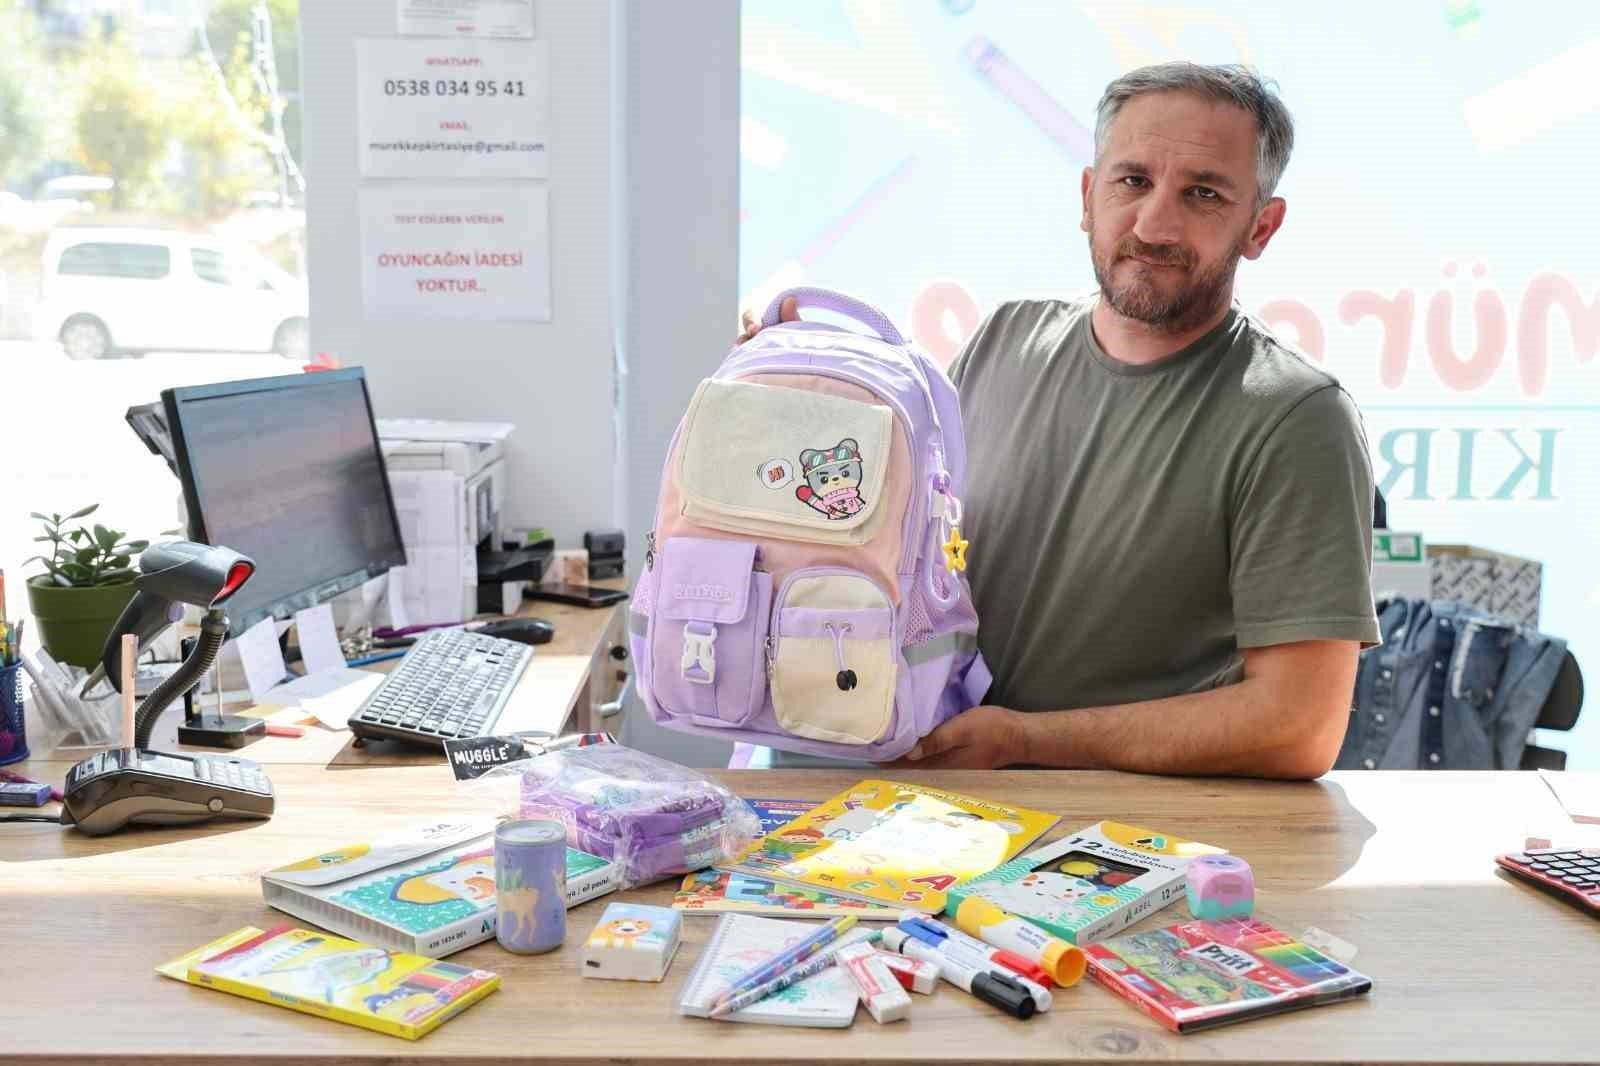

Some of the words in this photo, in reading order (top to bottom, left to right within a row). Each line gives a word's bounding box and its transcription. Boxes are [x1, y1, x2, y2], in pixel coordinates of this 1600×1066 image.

[384, 80, 430, 96] 0538
[436, 80, 469, 96] 034
[476, 80, 497, 96] 95
[503, 80, 525, 96] 41
[378, 250, 470, 267] OYUNCAĞIN
[475, 250, 523, 267] İADESİ
[454, 746, 509, 765] MUGGLE
[1069, 837, 1103, 851] 12
[1200, 944, 1254, 971] Pritt
